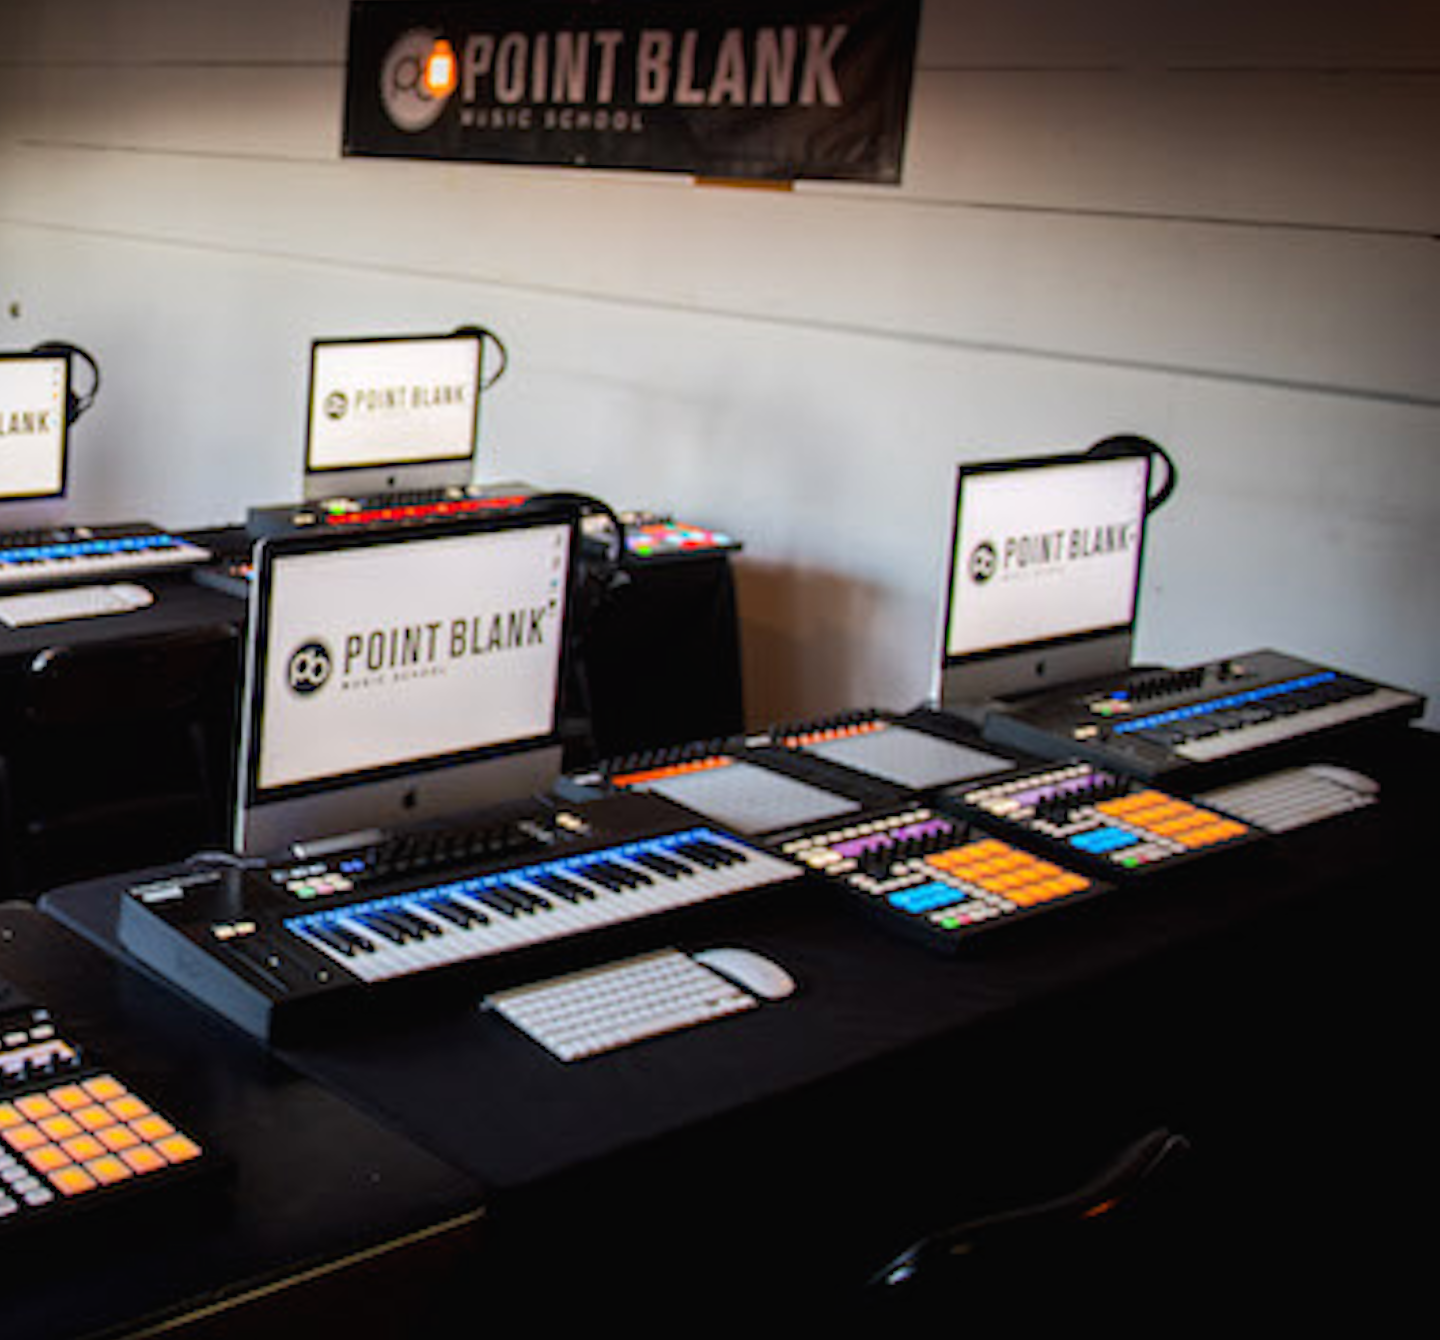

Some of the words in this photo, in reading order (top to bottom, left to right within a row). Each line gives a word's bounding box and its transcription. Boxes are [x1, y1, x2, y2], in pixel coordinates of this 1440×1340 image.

[463, 30, 624, 103] POINT
[635, 25, 848, 107] BLANK
[544, 107, 643, 131] SCHOOL
[355, 385, 406, 410] POINT
[411, 384, 464, 407] BLANK
[1005, 530, 1065, 568] POINT
[1069, 525, 1129, 560] BLANK
[344, 620, 443, 675] POINT
[450, 606, 546, 658] BLANK
